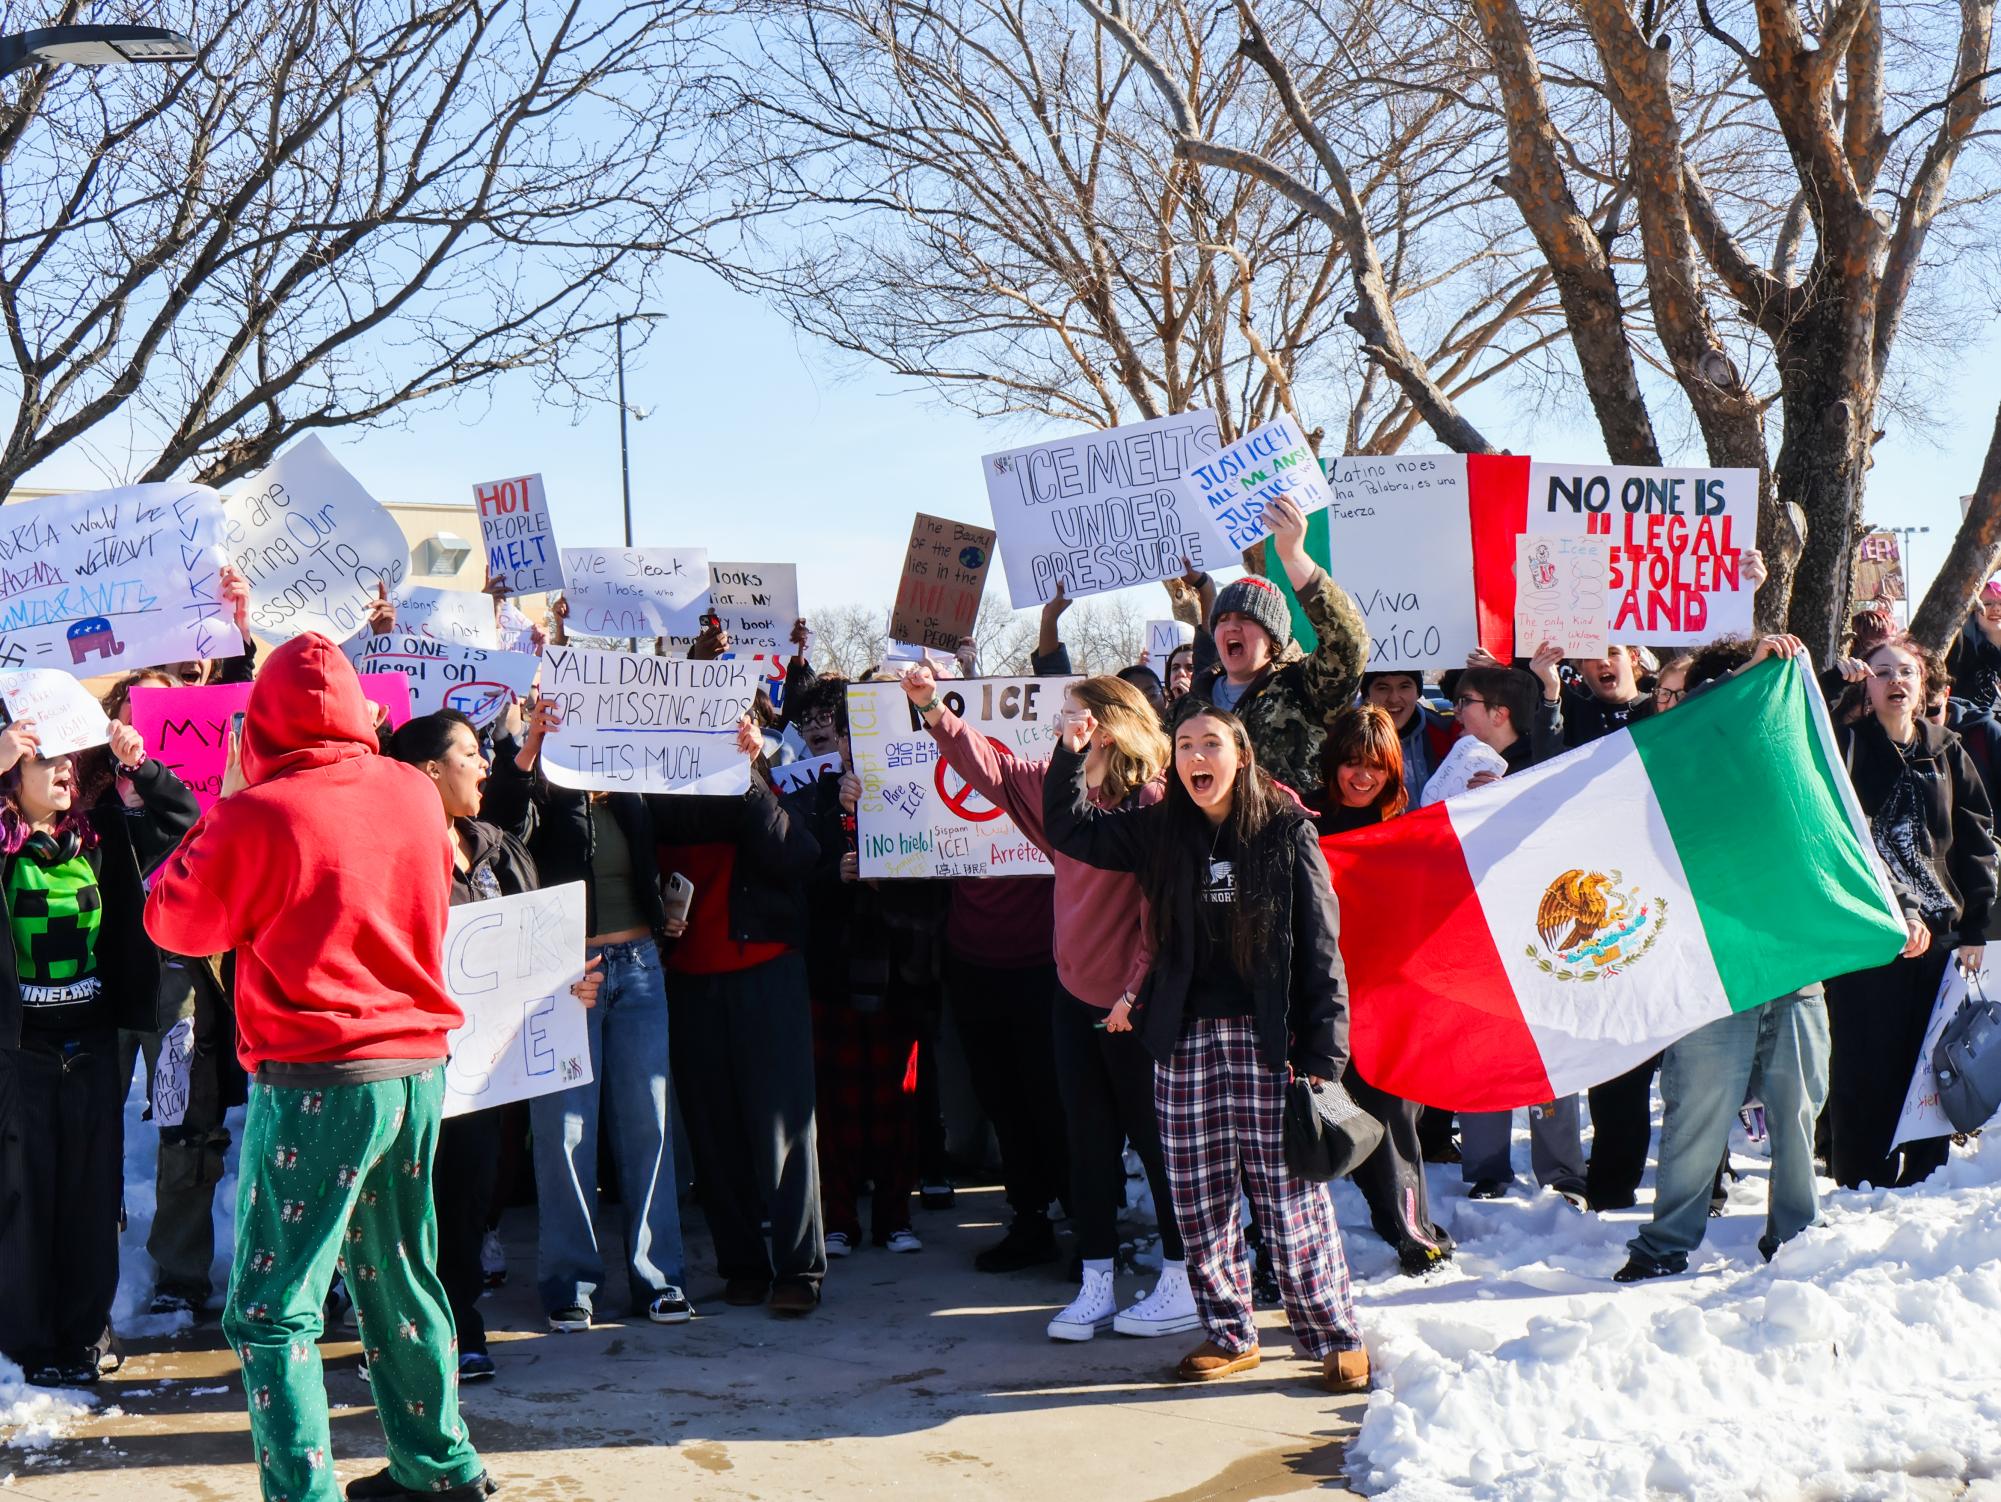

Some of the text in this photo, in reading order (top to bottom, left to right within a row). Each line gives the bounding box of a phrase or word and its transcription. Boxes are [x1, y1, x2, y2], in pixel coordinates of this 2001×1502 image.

[1014, 424, 1219, 506] ICE MELTS
[1327, 458, 1386, 486] Latino
[477, 477, 534, 516] HOT
[1417, 479, 1431, 489] es
[1437, 477, 1456, 487] una
[1547, 475, 1727, 517] NO ONE IS
[245, 483, 291, 527] are
[1206, 488, 1239, 510] ALL
[1215, 472, 1300, 530] JUSTICE
[1331, 503, 1376, 521] Fuerza
[285, 504, 337, 548] Our
[483, 512, 549, 542] PEOPLE
[917, 514, 991, 549] The Beauty
[1051, 488, 1181, 549] UNDER
[1228, 514, 1266, 551] FOR
[490, 535, 547, 576] MELT
[932, 542, 952, 558] the
[1558, 538, 1599, 556] Icee
[567, 553, 607, 575] We
[713, 567, 764, 587] looks
[908, 555, 978, 586] lies in the
[1031, 531, 1204, 601] PRESSURE
[251, 570, 327, 629] essons
[571, 578, 589, 595] for
[605, 581, 645, 598] Those
[751, 593, 773, 607] My
[307, 595, 368, 634] You
[1354, 589, 1420, 618] Viva
[1612, 589, 1708, 633] AND
[741, 617, 776, 631] book
[1517, 612, 1538, 627] The
[1544, 615, 1565, 630] only
[1523, 629, 1536, 641] of
[364, 636, 392, 656] NO
[403, 637, 450, 657] ONE
[463, 648, 488, 662] is
[727, 633, 781, 648] ctures.
[923, 628, 961, 651] PEOPL
[443, 663, 477, 684] on
[690, 663, 748, 689] LOOK
[541, 691, 752, 728] FOR MISSING KIDS
[981, 683, 1041, 722] ICE
[570, 743, 634, 781] THIS
[882, 783, 906, 806] Pare
[899, 828, 934, 856] hielo!
[991, 841, 1047, 866] Arrêtez
[447, 896, 567, 996] CK
[447, 995, 556, 1096] CE
